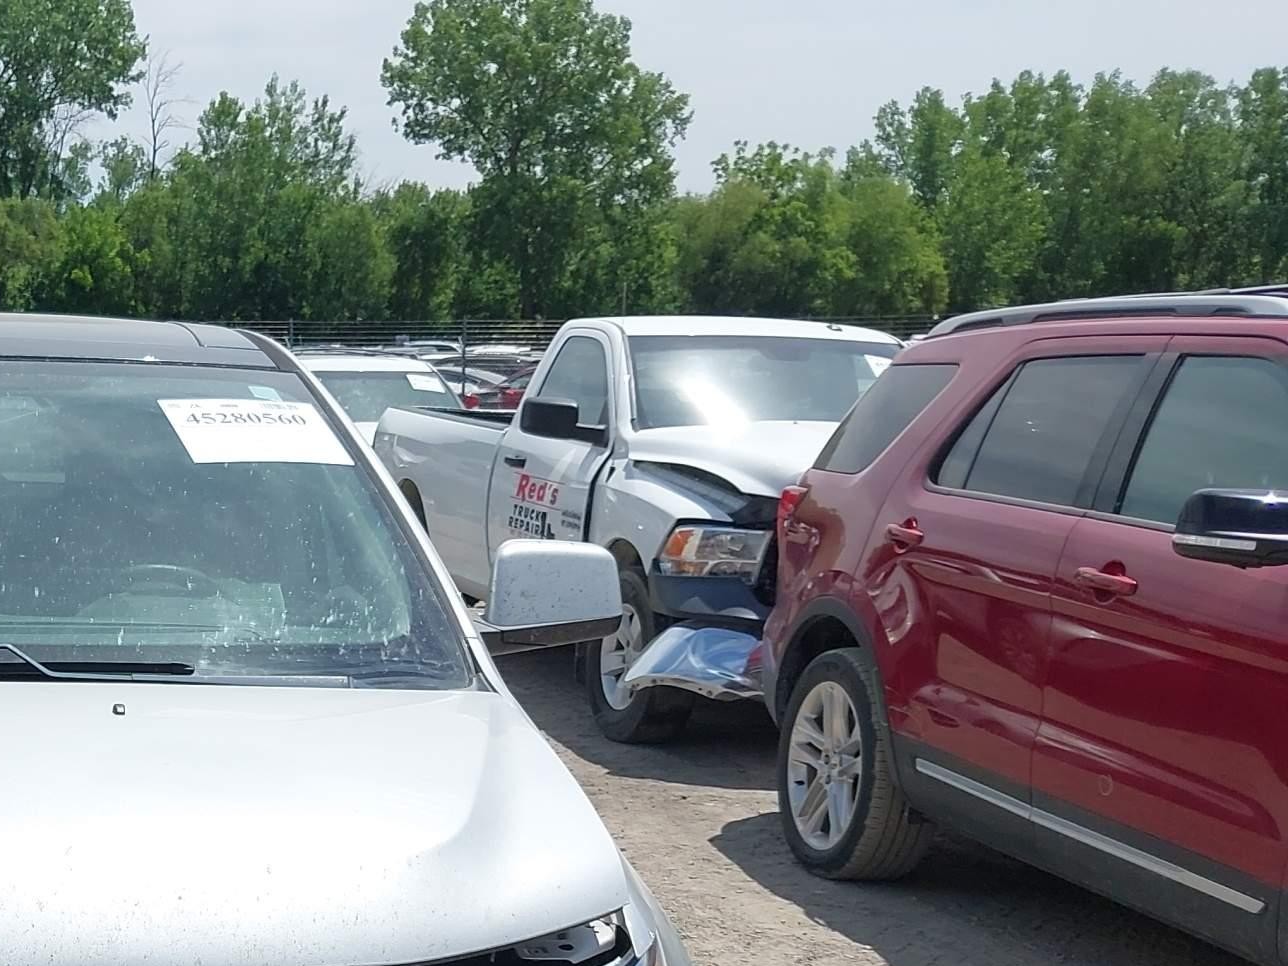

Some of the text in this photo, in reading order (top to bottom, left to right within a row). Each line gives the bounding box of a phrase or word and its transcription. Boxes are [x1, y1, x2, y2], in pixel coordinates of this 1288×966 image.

[186, 412, 307, 426] 45280560
[515, 473, 559, 506] Red's
[512, 503, 541, 522] TRUCK
[508, 515, 541, 536] REPAIR
